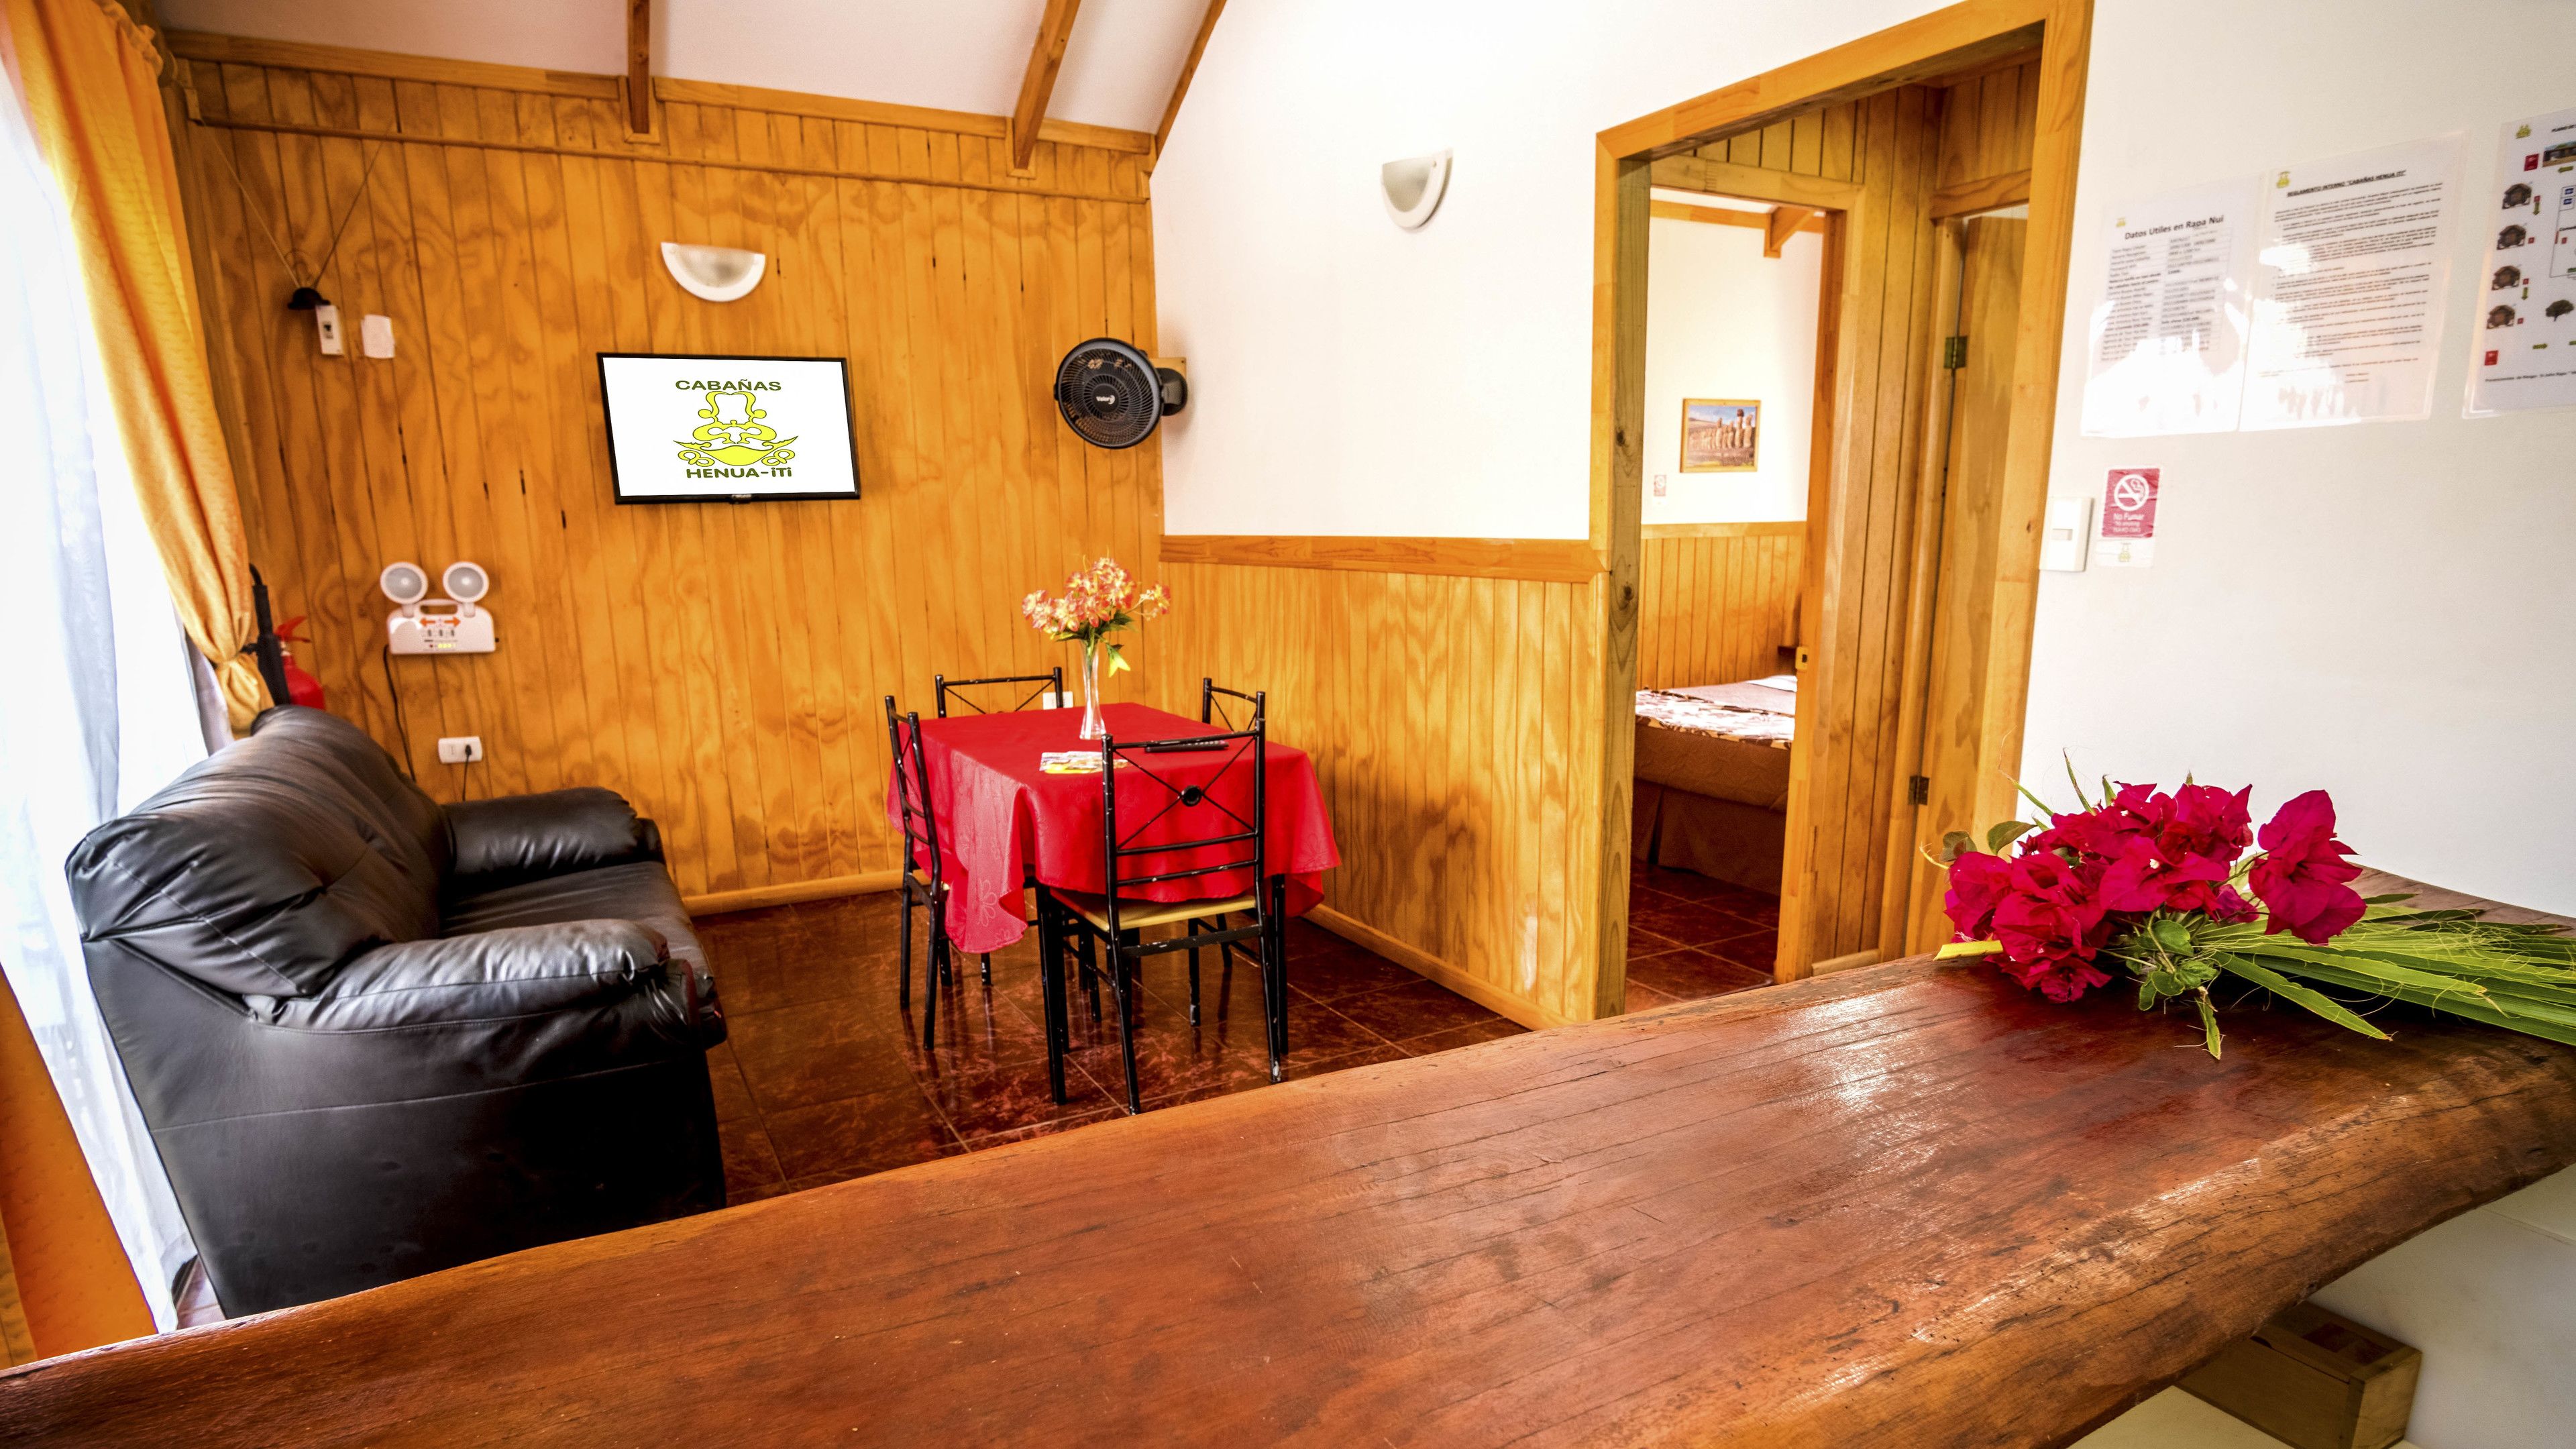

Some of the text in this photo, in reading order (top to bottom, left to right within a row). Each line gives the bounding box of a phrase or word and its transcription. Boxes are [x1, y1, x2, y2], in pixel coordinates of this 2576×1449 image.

[2125, 229, 2147, 239] Datos
[2149, 225, 2171, 235] Utiles
[2186, 219, 2207, 229] Rapa
[2208, 215, 2224, 224] Nui
[675, 378, 782, 392] CABAÑAS
